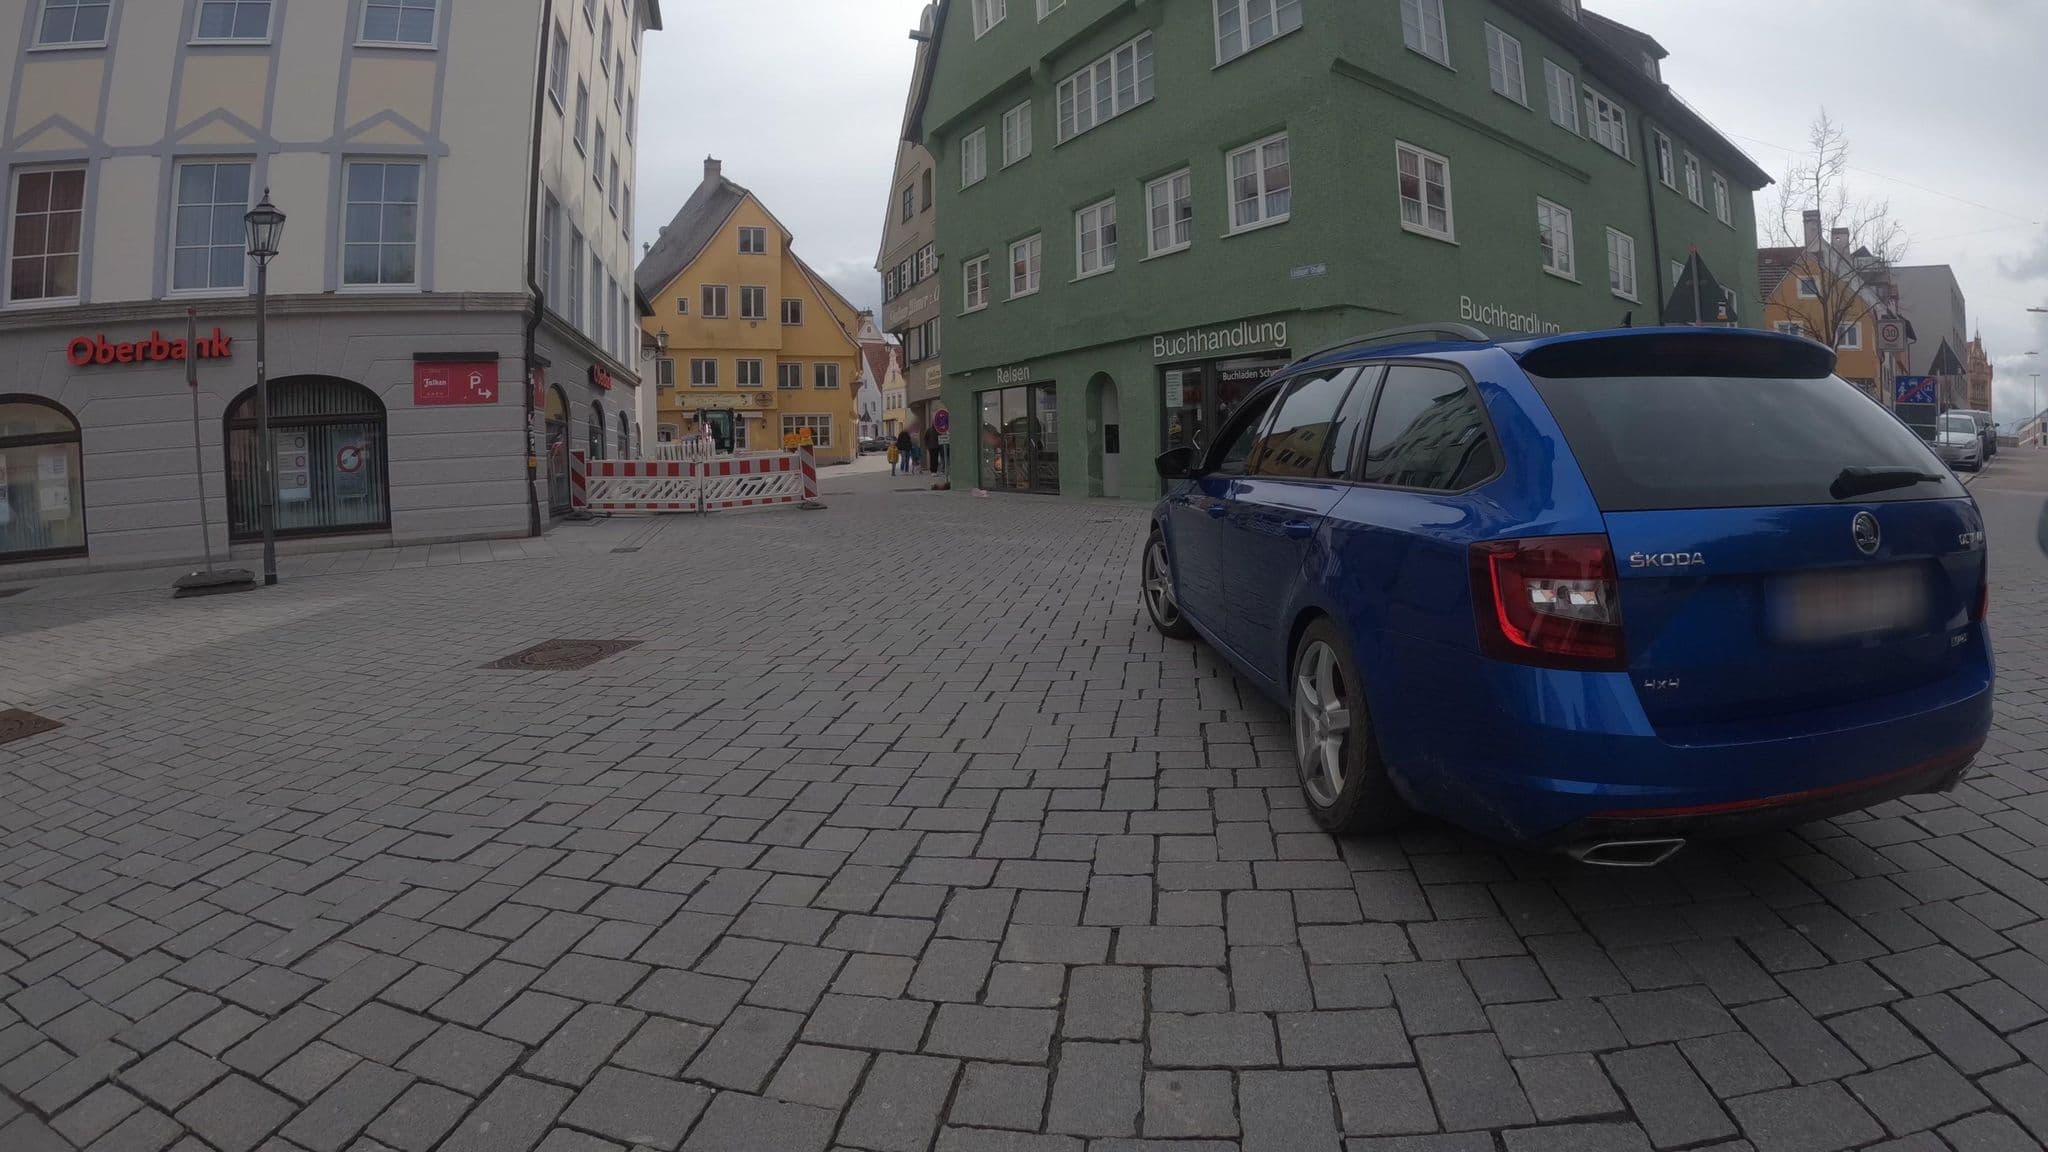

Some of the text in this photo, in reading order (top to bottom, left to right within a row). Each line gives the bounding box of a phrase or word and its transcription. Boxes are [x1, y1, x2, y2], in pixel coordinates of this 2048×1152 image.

[66, 327, 232, 366] Oberbank
[1153, 321, 1287, 358] Buchhandlung
[469, 376, 482, 389] P
[997, 366, 1030, 384] Reisen
[1222, 369, 1258, 381] Buchladen
[1630, 551, 1706, 568] ŠKODA
